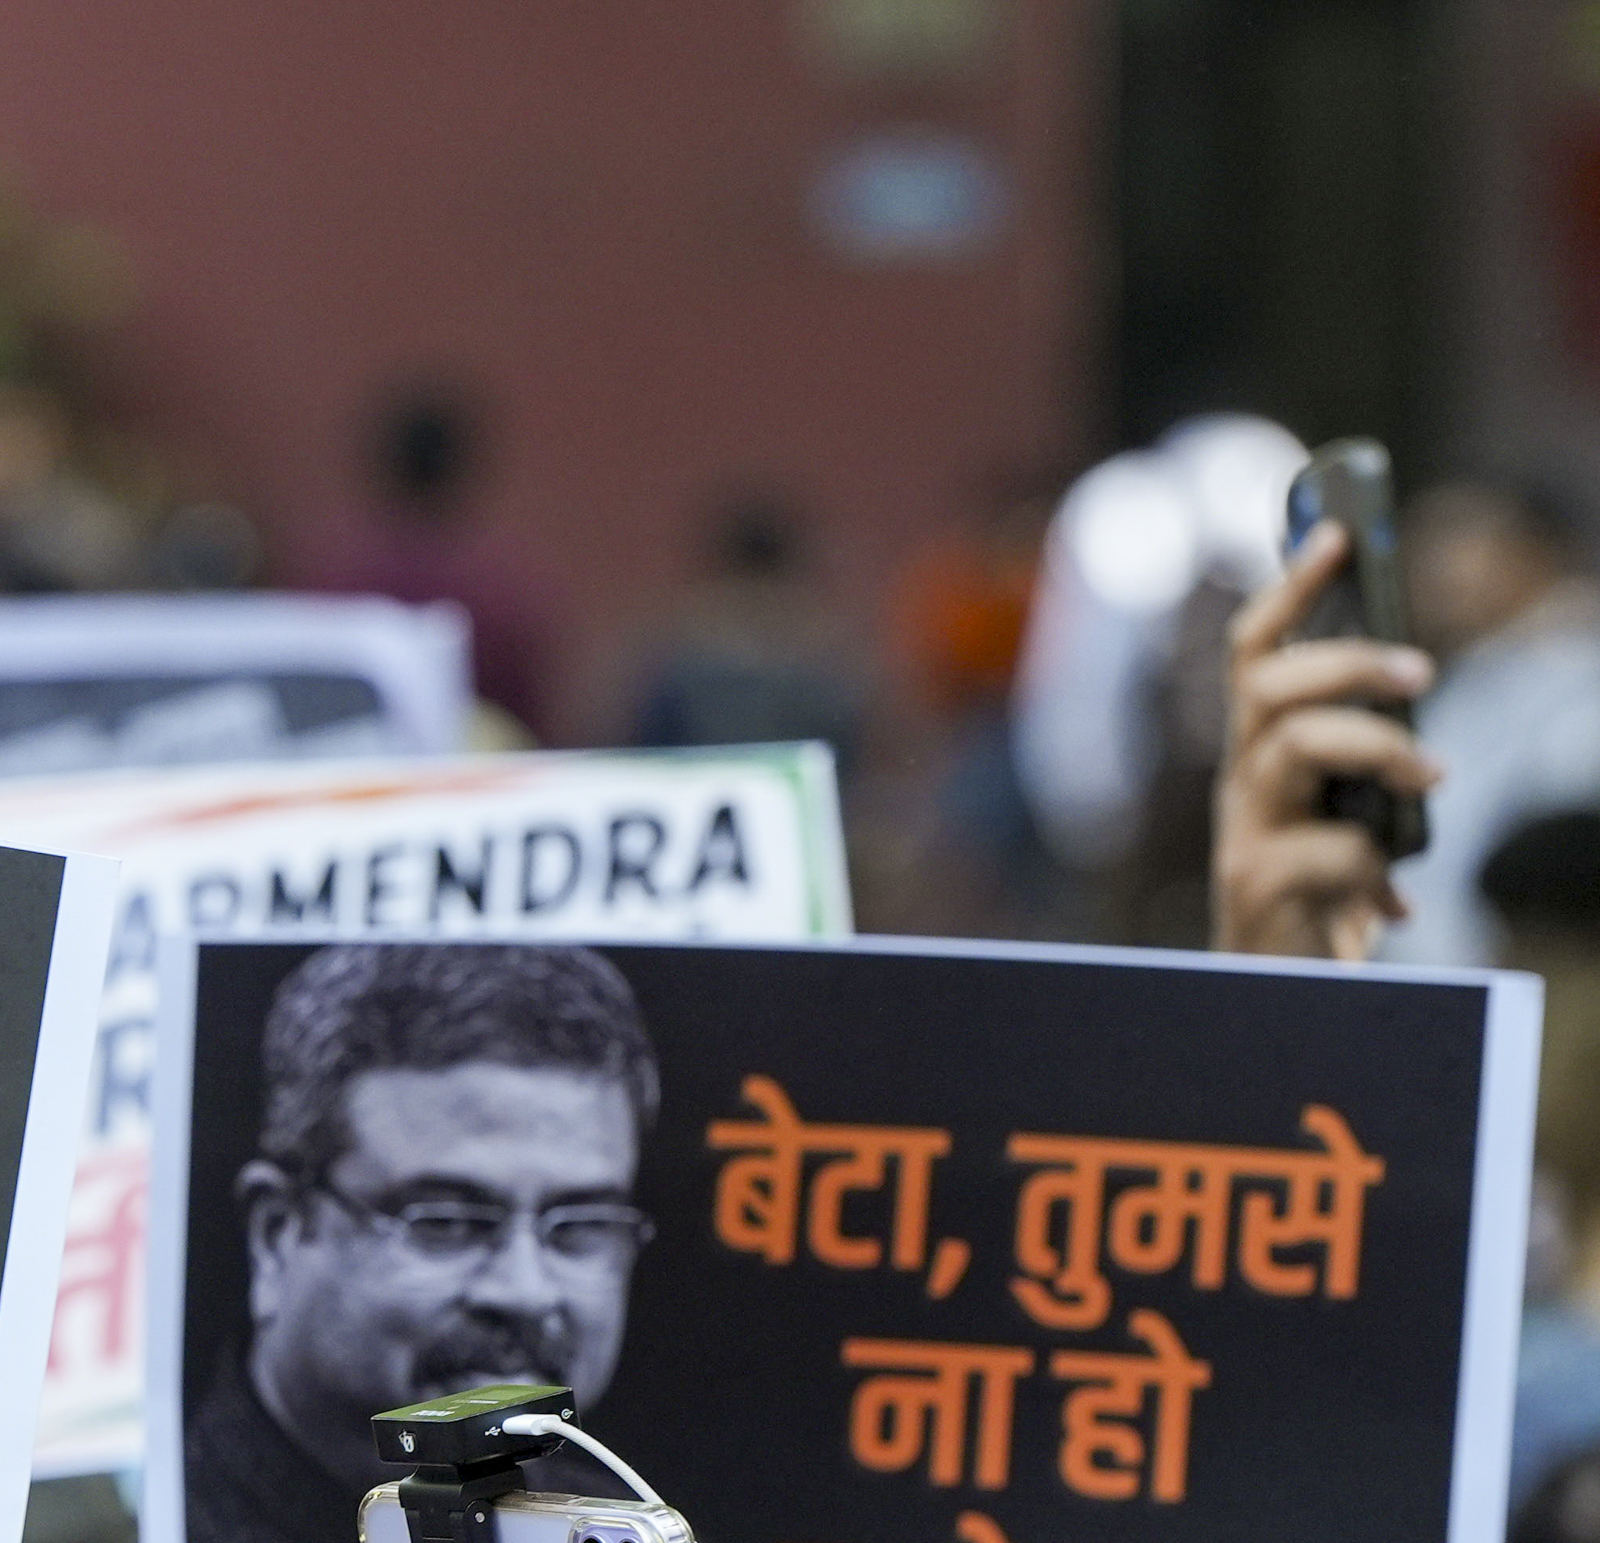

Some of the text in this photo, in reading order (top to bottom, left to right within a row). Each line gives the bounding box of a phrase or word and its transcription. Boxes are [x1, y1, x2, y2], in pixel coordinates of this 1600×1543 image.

[708, 1076, 1386, 1329] बेटा, तुमसे
[842, 1310, 1212, 1504] ना हो
